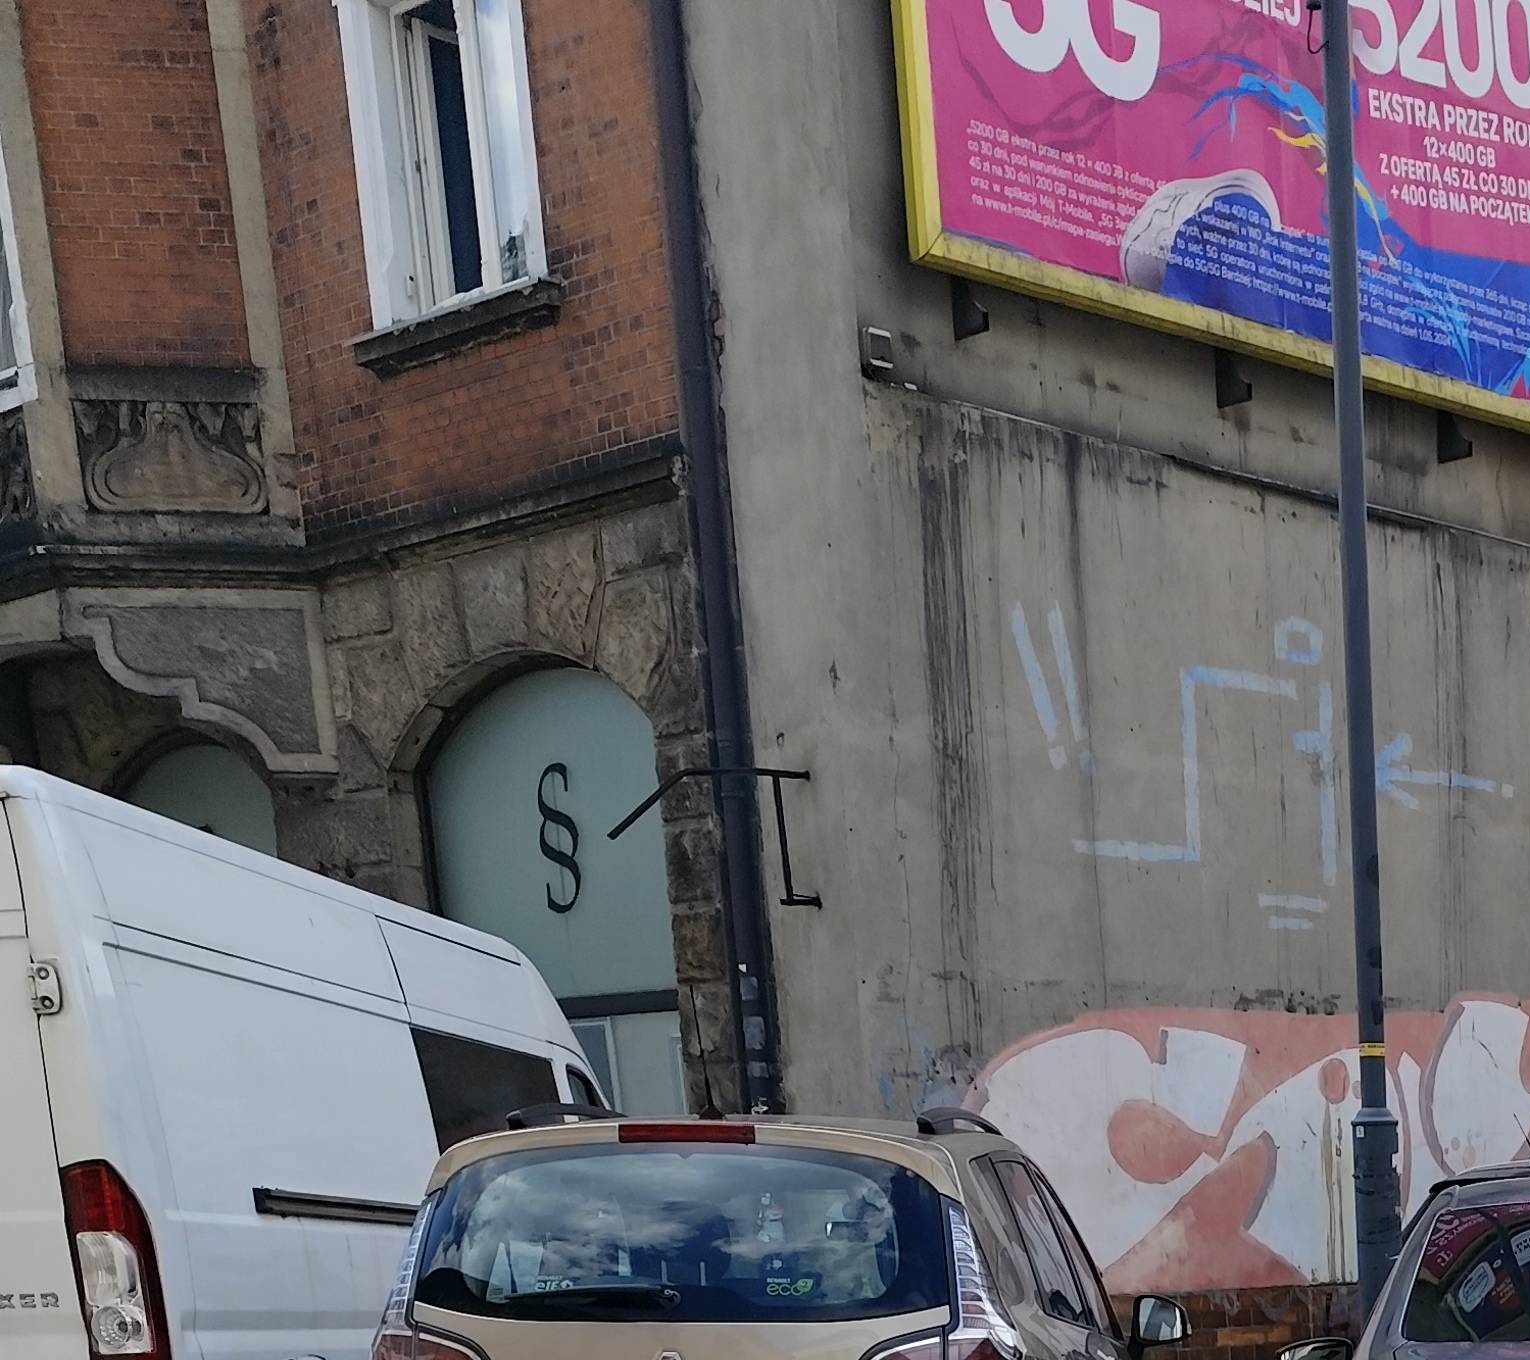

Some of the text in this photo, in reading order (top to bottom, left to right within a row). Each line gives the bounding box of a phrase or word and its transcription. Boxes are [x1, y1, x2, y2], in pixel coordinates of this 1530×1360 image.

[1368, 88, 1441, 131] EKSTRA
[1443, 103, 1500, 142] PRZEZ
[1379, 153, 1389, 175] Z
[1390, 157, 1444, 189] OFERTĄ
[1443, 166, 1460, 188] 45
[1461, 168, 1478, 191] ZŁ
[1479, 173, 1498, 194] CO
[1500, 175, 1517, 197] 30
[1476, 145, 1496, 168] GB
[1401, 184, 1427, 206] 400
[1428, 189, 1449, 210] GB
[1450, 192, 1470, 214] NA
